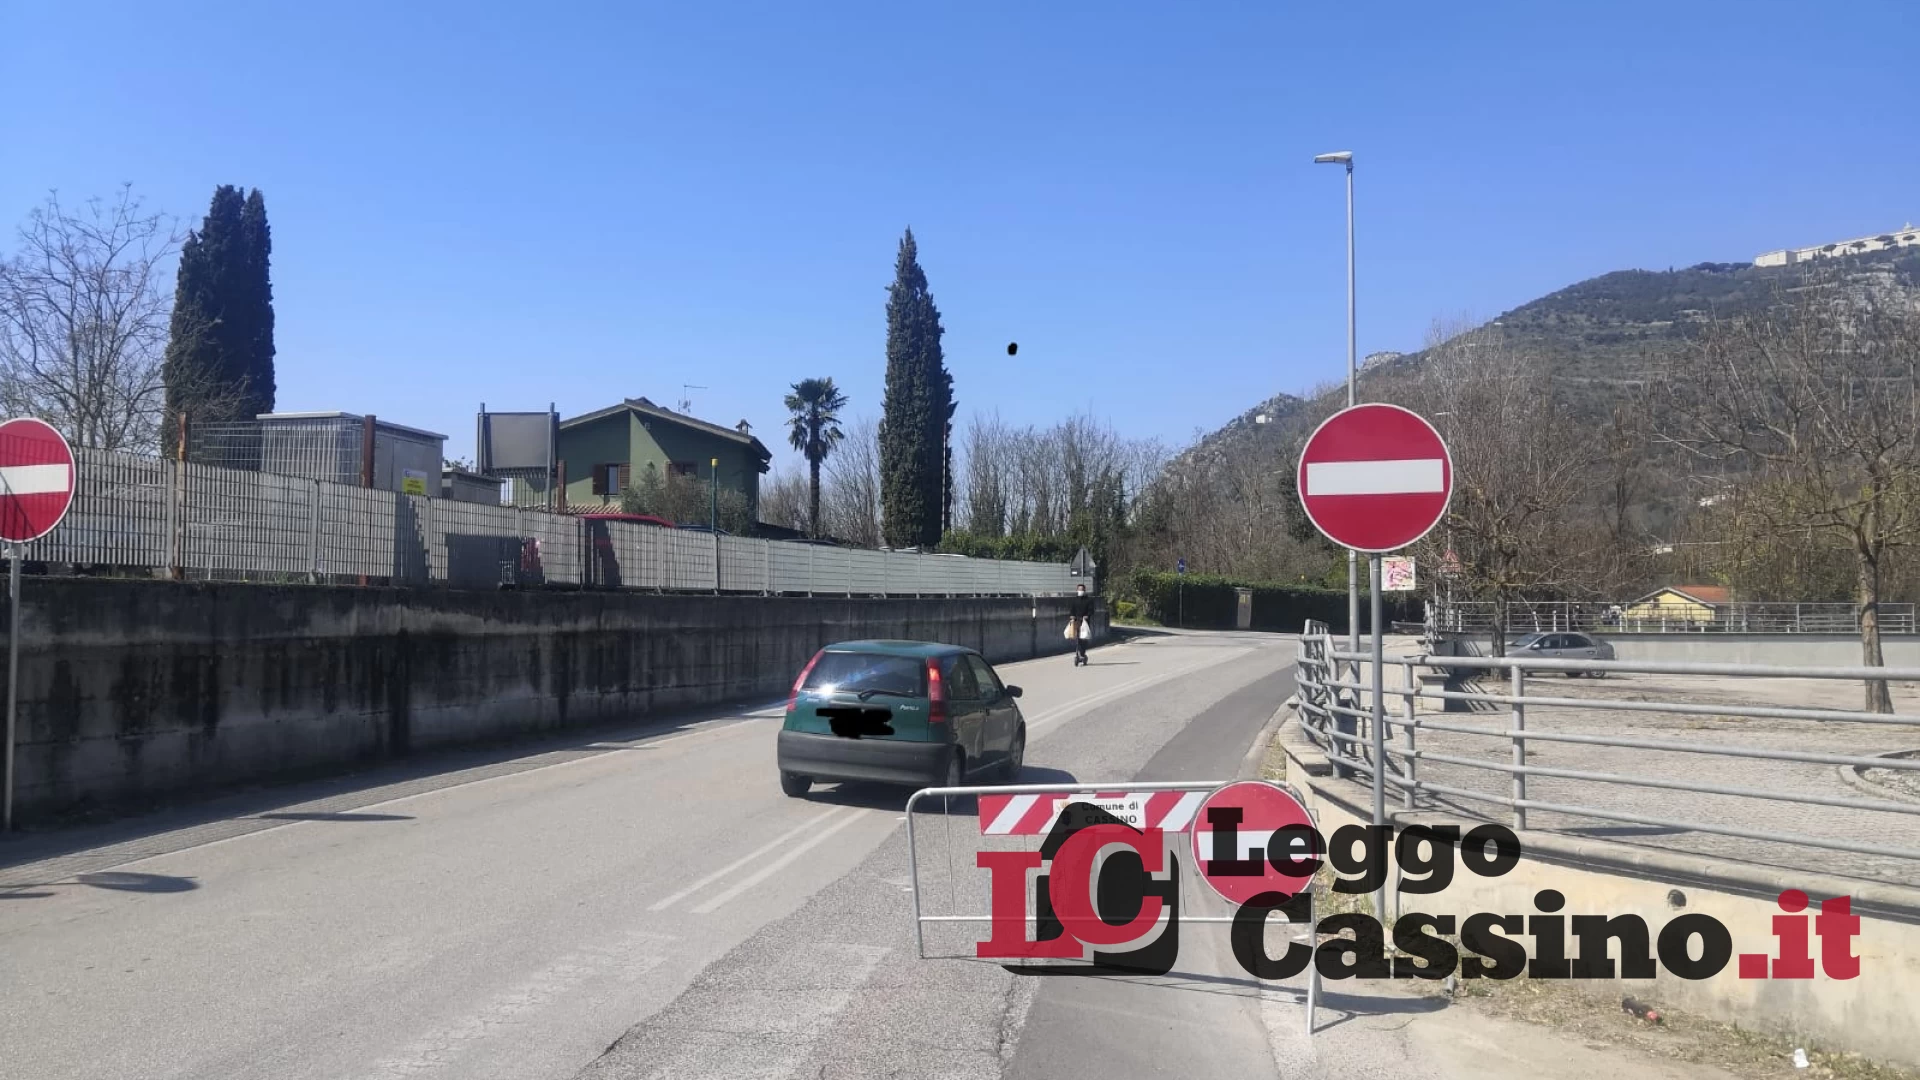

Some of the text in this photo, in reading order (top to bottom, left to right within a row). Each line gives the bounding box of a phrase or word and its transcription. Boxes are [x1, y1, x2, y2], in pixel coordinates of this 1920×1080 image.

[1082, 801, 1139, 811] Comune di
[1085, 815, 1137, 824] CASSINO
